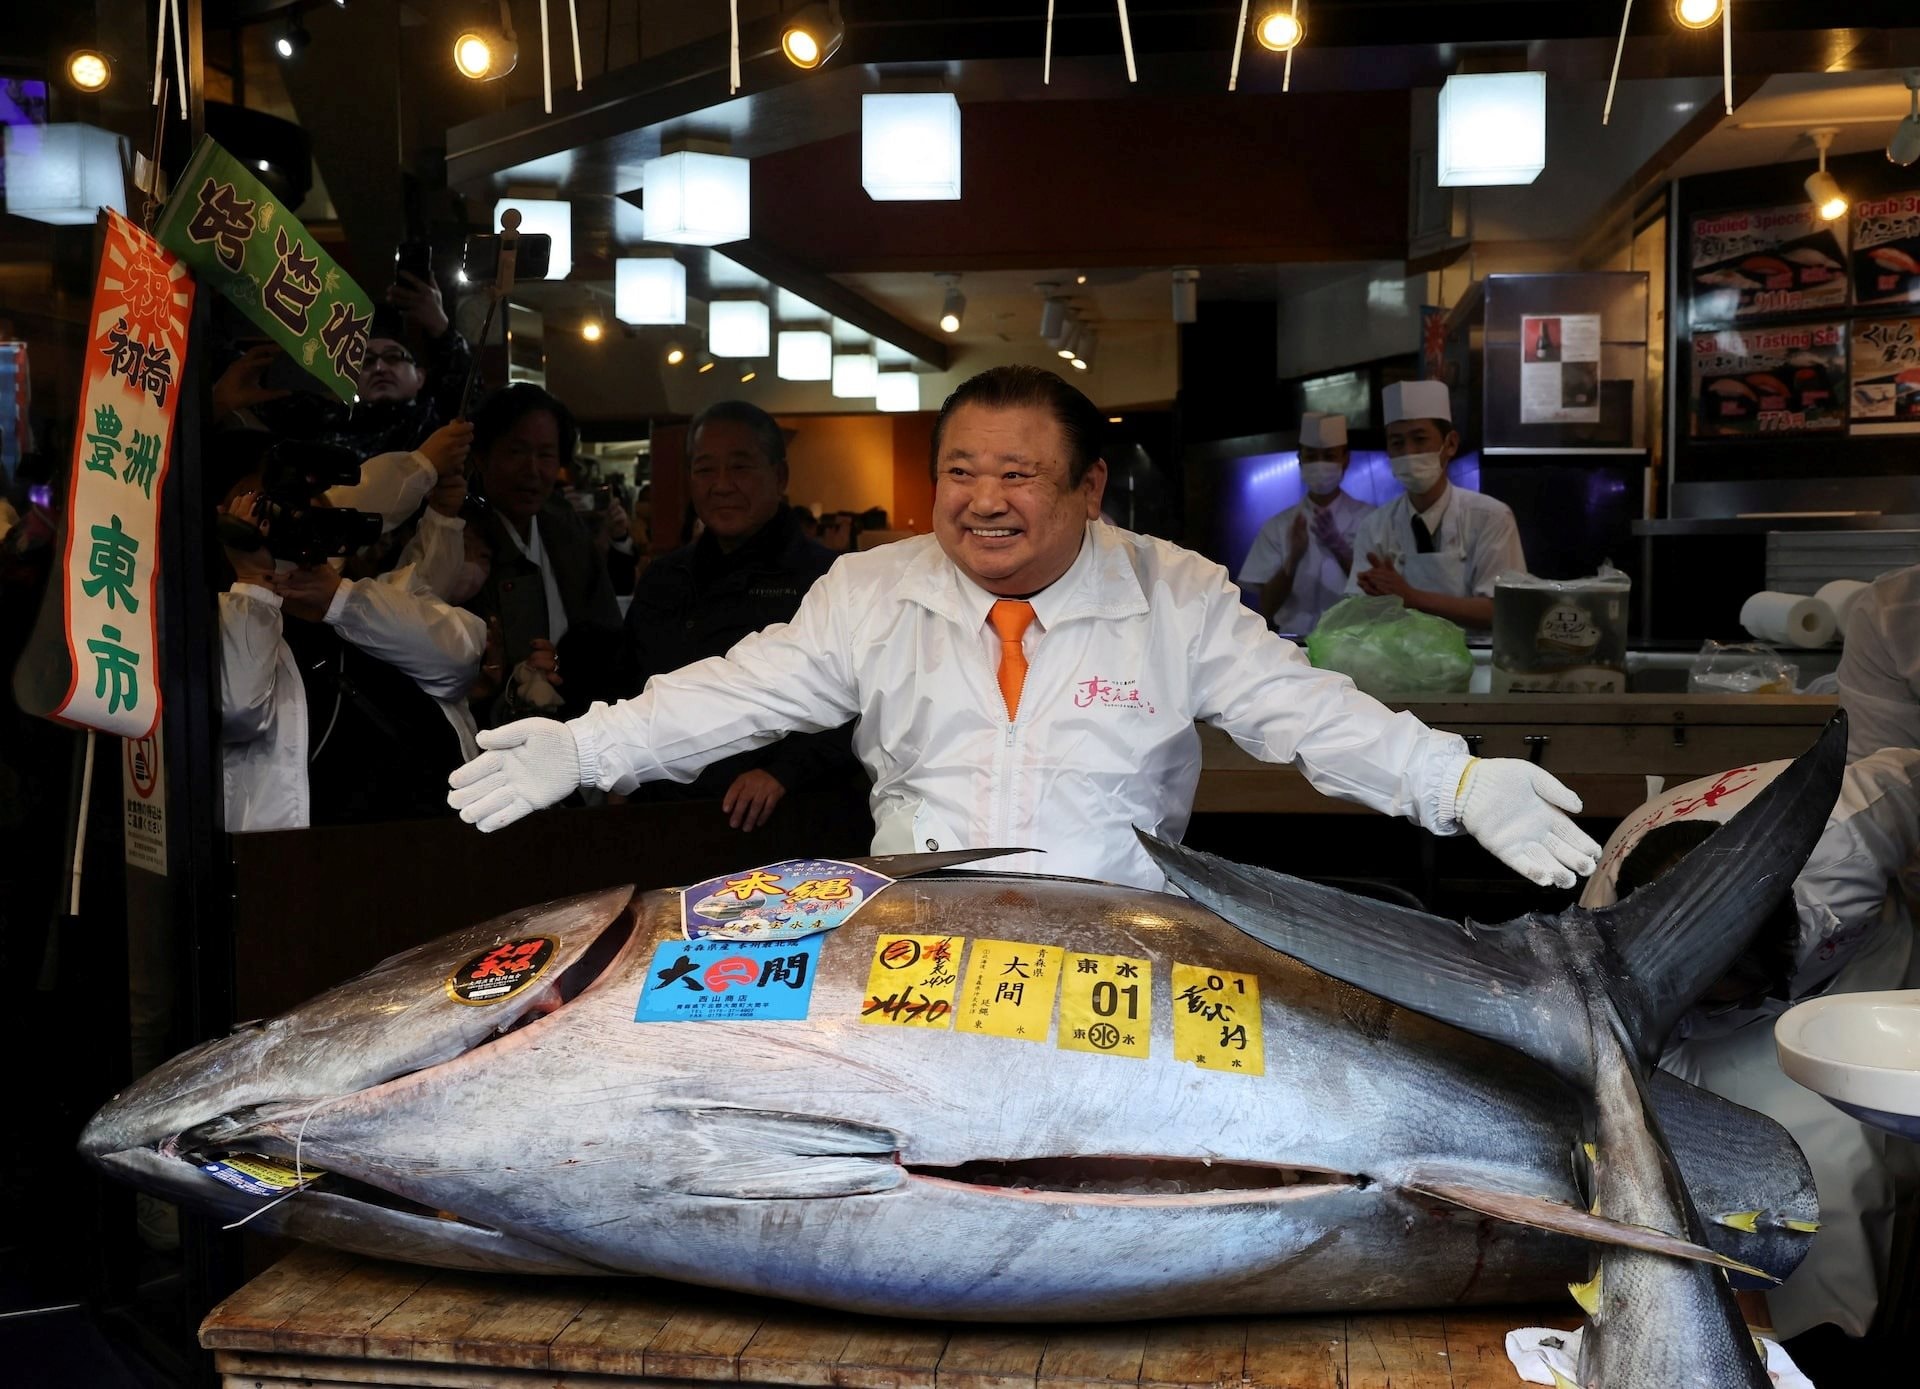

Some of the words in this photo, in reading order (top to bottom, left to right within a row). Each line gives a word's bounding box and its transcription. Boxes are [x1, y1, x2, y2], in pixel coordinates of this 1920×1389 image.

[1859, 196, 1898, 217] Crab
[1696, 217, 1748, 235] Broiled
[121, 253, 172, 332] 祝
[1756, 332, 1809, 350] Tasting
[102, 317, 171, 408] 初荷
[85, 404, 161, 500] 豊洲
[81, 514, 140, 715] 東市
[1545, 621, 1586, 632] クッキング
[1556, 612, 1577, 622] エコ
[1033, 949, 1049, 978] 青森県
[994, 956, 1030, 1007] 大間
[1207, 975, 1246, 994] 01
[699, 994, 748, 1003] 西山商店
[1091, 981, 1138, 1020] 01
